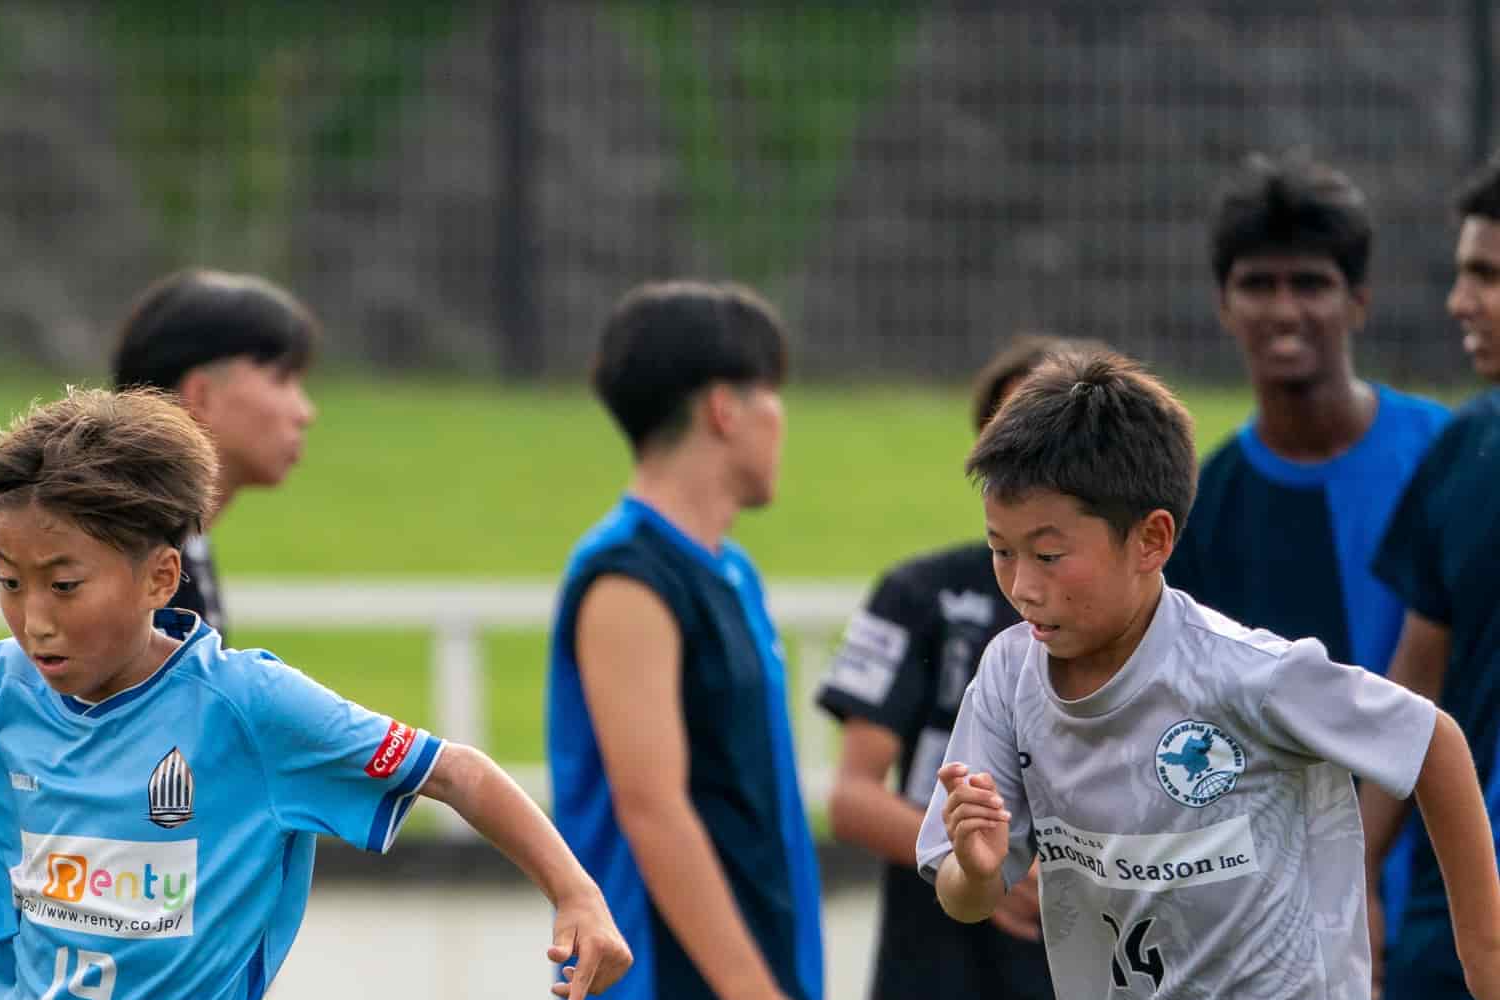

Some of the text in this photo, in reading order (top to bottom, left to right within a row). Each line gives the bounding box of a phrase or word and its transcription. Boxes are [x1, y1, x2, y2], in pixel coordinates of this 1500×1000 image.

[43, 853, 188, 911] Renty
[1116, 856, 1214, 881] Season
[1219, 853, 1250, 869] Inc.
[1101, 912, 1165, 993] 14
